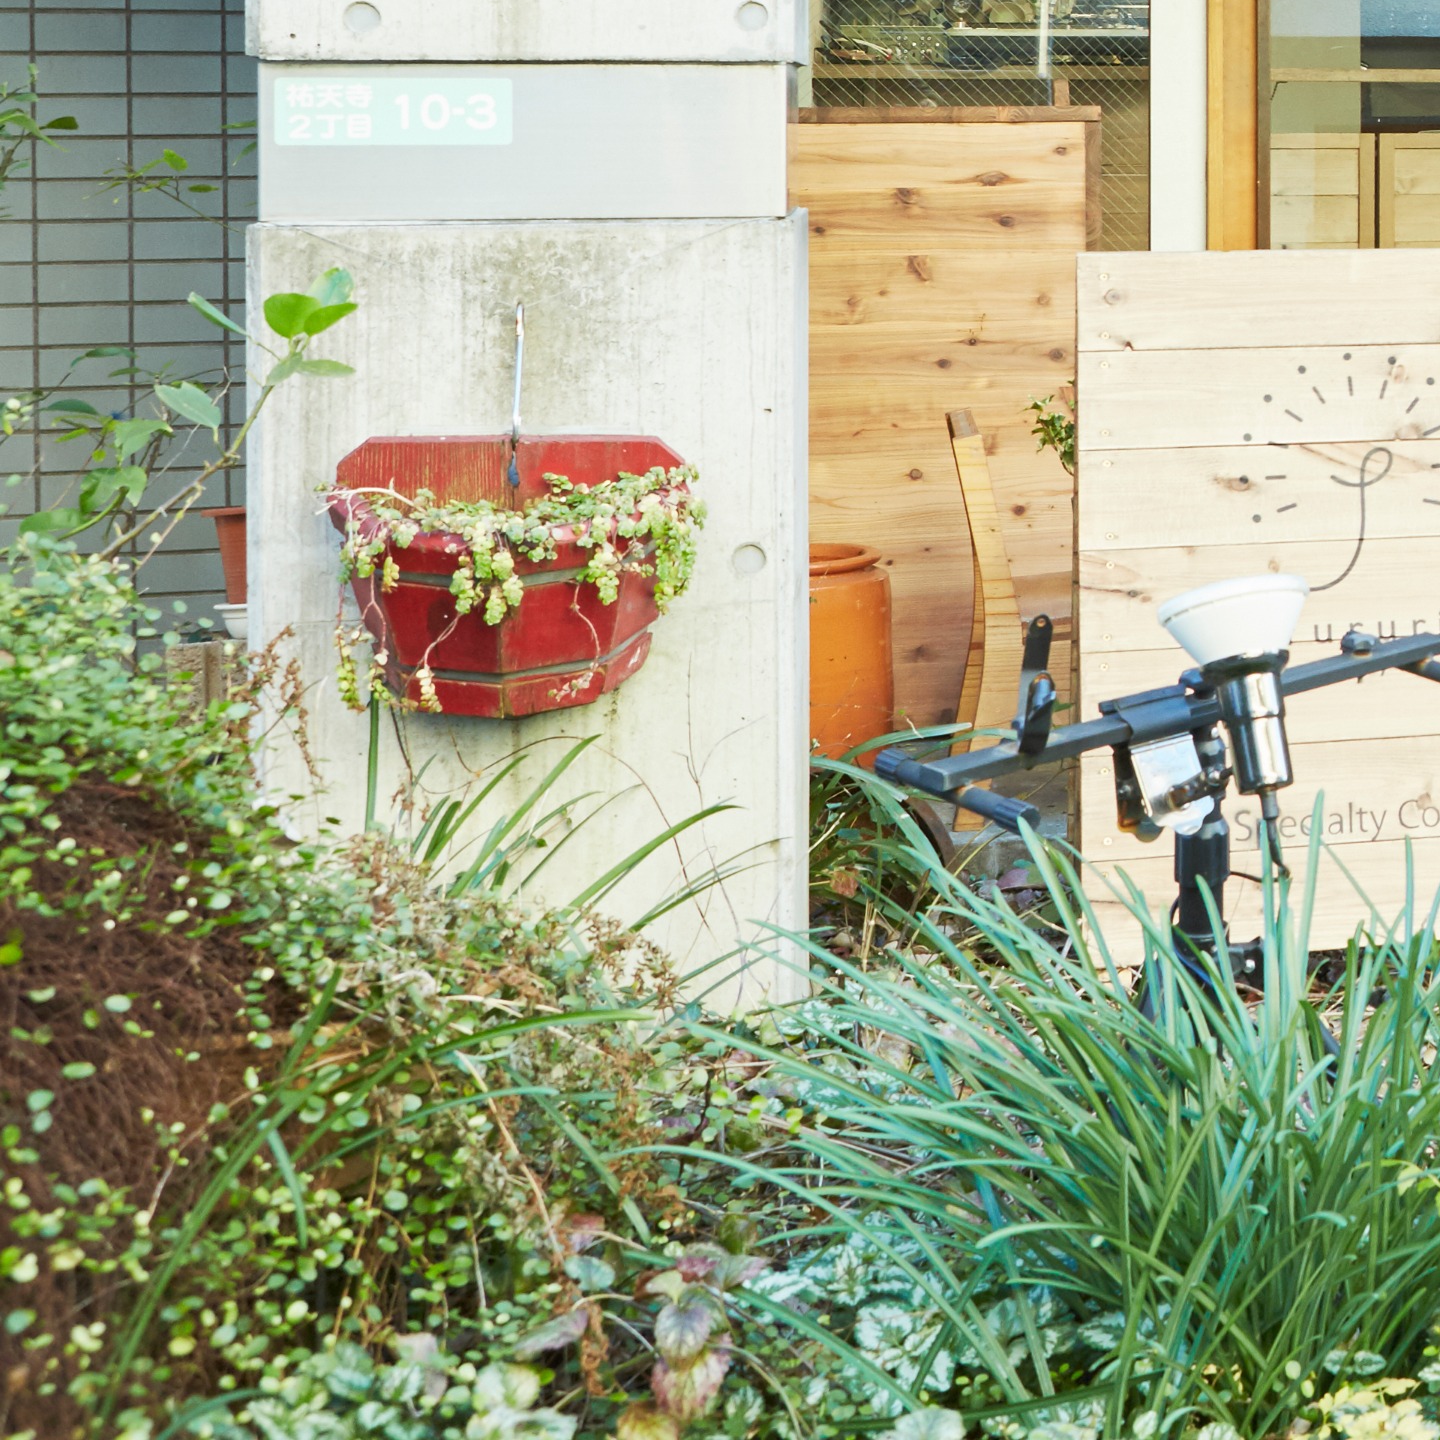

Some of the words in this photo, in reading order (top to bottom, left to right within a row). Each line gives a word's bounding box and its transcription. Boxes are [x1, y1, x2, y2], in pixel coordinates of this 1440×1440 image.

[286, 83, 374, 109] 祐天寺
[394, 92, 499, 131] 10-3
[286, 113, 374, 139] 2丁目
